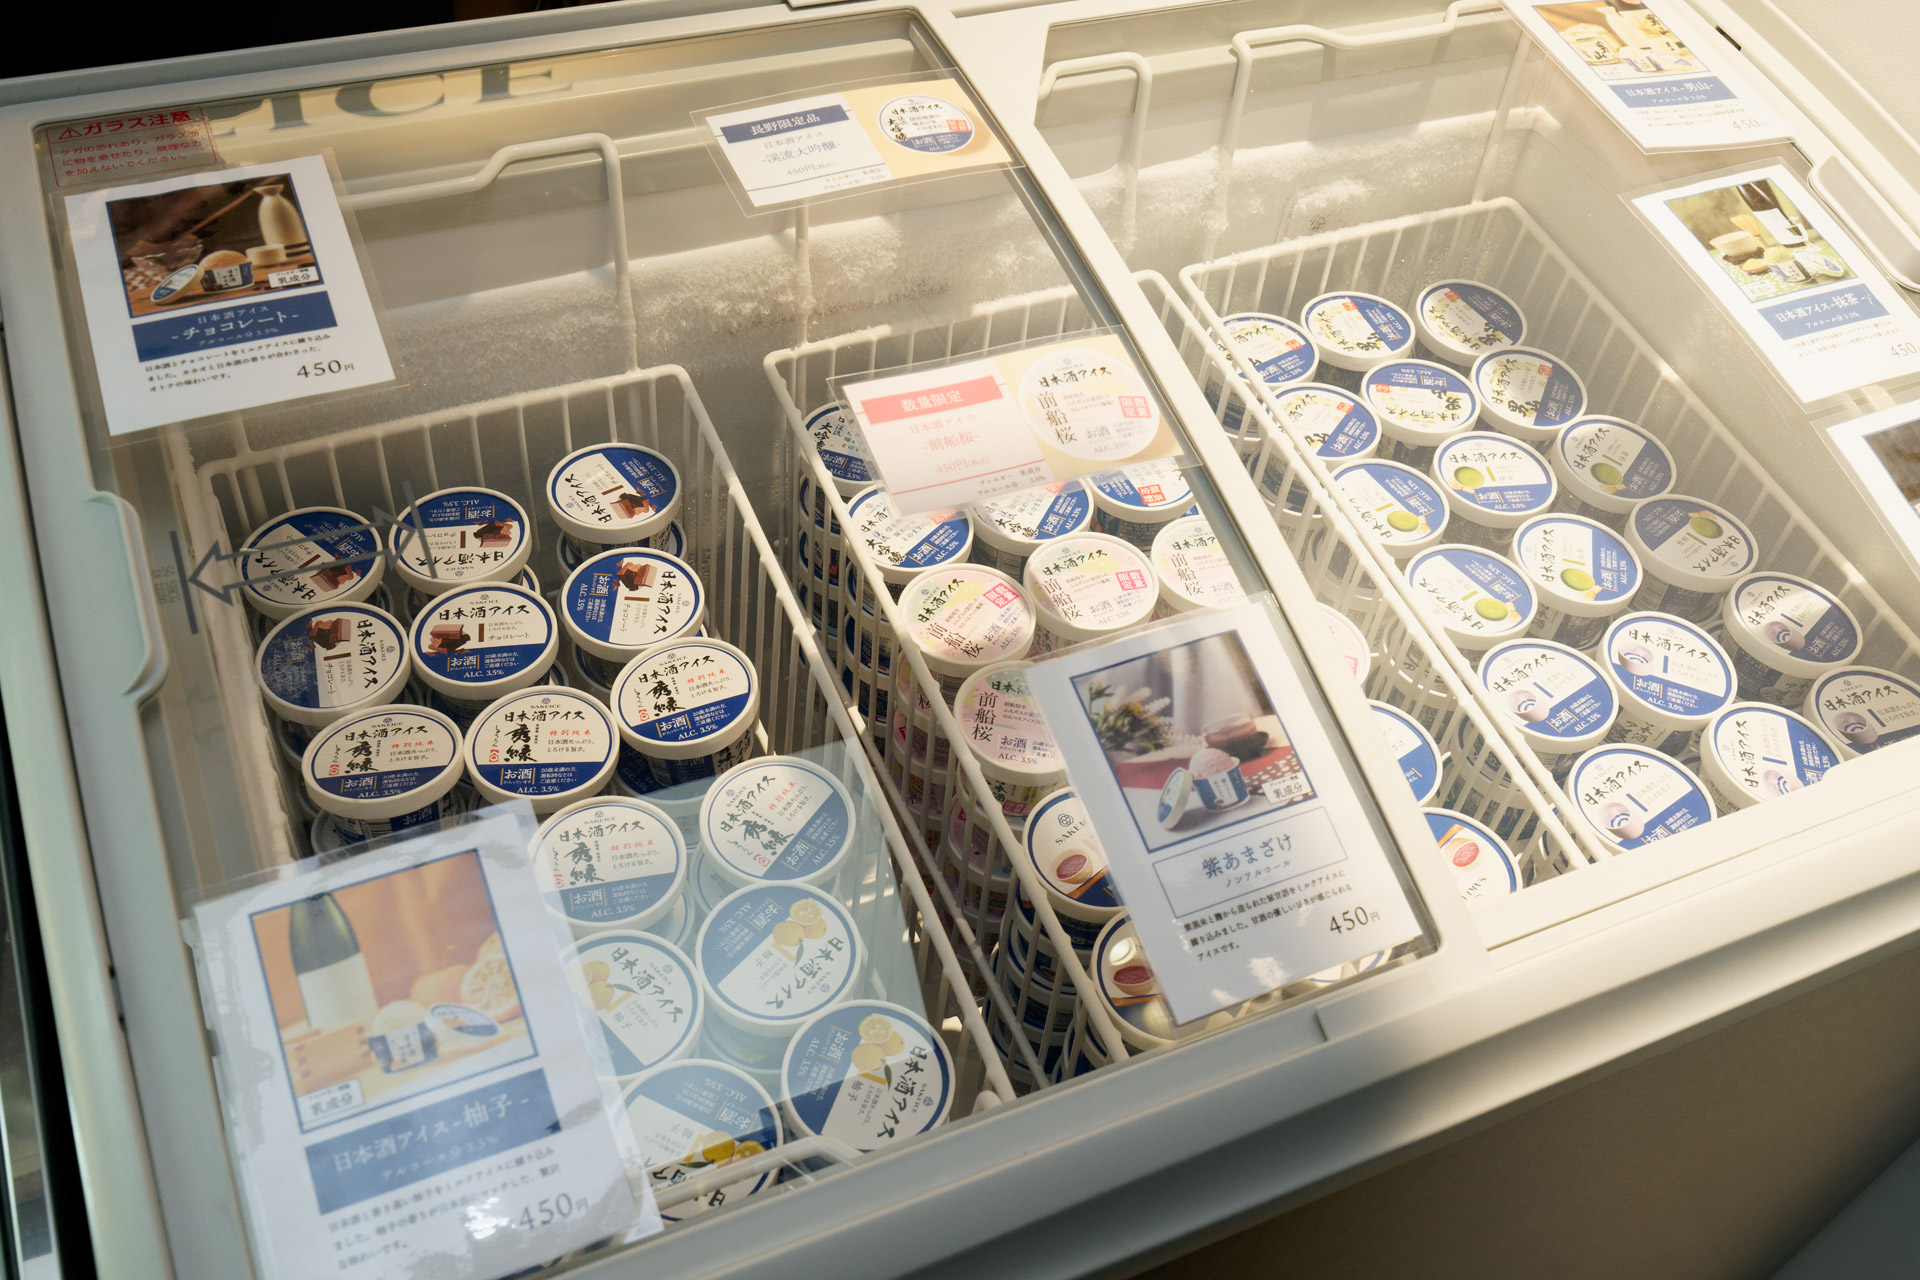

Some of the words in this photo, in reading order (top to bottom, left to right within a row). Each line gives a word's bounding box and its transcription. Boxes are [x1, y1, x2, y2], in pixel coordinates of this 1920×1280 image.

[83, 110, 192, 136] ガラス注意
[751, 112, 821, 137] 長野限定品
[764, 131, 824, 150] 日本酒アイス
[198, 306, 269, 324] 日本酒アイス
[297, 359, 354, 379] 450円
[1038, 366, 1111, 388] 日本酒アイス
[901, 390, 964, 412] 数量限定
[910, 414, 977, 435] 日本酒アイス
[1036, 391, 1077, 444] 前船桜
[1449, 452, 1522, 464] 日本酒アイス
[1574, 427, 1610, 470] 日本酒アイス
[565, 474, 612, 523] 日本酒アイス
[1042, 549, 1108, 576] 日本酒アイス
[654, 571, 677, 635] 日本酒アイス
[918, 578, 964, 622] 日本酒アイス
[439, 605, 530, 620] 日本酒アイス
[488, 633, 530, 641] チョコレート
[1628, 628, 1711, 664] 日本酒アイス
[357, 619, 378, 688] 日本酒アイス
[450, 656, 477, 667] お酒
[486, 669, 505, 677] 3.5%
[638, 655, 715, 683] 日本酒アイス
[687, 669, 726, 684] 特別純米
[1492, 653, 1555, 693] 日本酒アイス
[1636, 678, 1661, 692] お酒
[1647, 696, 1666, 707] ALC.
[1823, 685, 1899, 712] 日本酒アイス
[504, 711, 586, 723] 日本酒アイス
[660, 715, 686, 731] お酒
[972, 692, 998, 742] 前船桜
[345, 725, 429, 742] 日本酒アイス
[678, 731, 698, 740] ALC.
[700, 723, 718, 734] 3.5%
[392, 740, 435, 749] 特別純米
[1000, 736, 1028, 749] お酒
[998, 753, 1018, 762] ALC.
[1020, 756, 1038, 765] 3.5%
[1736, 719, 1759, 788] 日本酒アイス
[344, 776, 373, 788] お酒
[504, 768, 533, 780] お酒
[1584, 760, 1649, 806] 日本酒アイス
[358, 791, 380, 799] ALC.
[720, 775, 776, 833] 日本酒アイス
[584, 816, 616, 825] SAKEICE
[559, 821, 646, 842] 日本酒アイス
[611, 840, 655, 851] 特別純米
[786, 840, 810, 865] お酒
[813, 847, 829, 866] ALC.
[1202, 833, 1294, 880] 紫あまざけ
[1225, 859, 1291, 888] ノンアルコール
[574, 889, 603, 904] お酒
[591, 908, 614, 918] ALC.
[616, 905, 636, 915] 3.5%
[1329, 904, 1381, 935] 450円
[1197, 943, 1241, 962] アイスです。
[766, 936, 845, 1009] 日本酒アイス
[611, 947, 683, 1024] 日本酒アイス
[612, 1011, 632, 1029] 柚子
[827, 1031, 848, 1061] お酒
[848, 1080, 864, 1102] 柚子
[877, 1045, 928, 1139] 日本酒アイス
[719, 1107, 751, 1129] お酒
[518, 1192, 589, 1232] 450円
